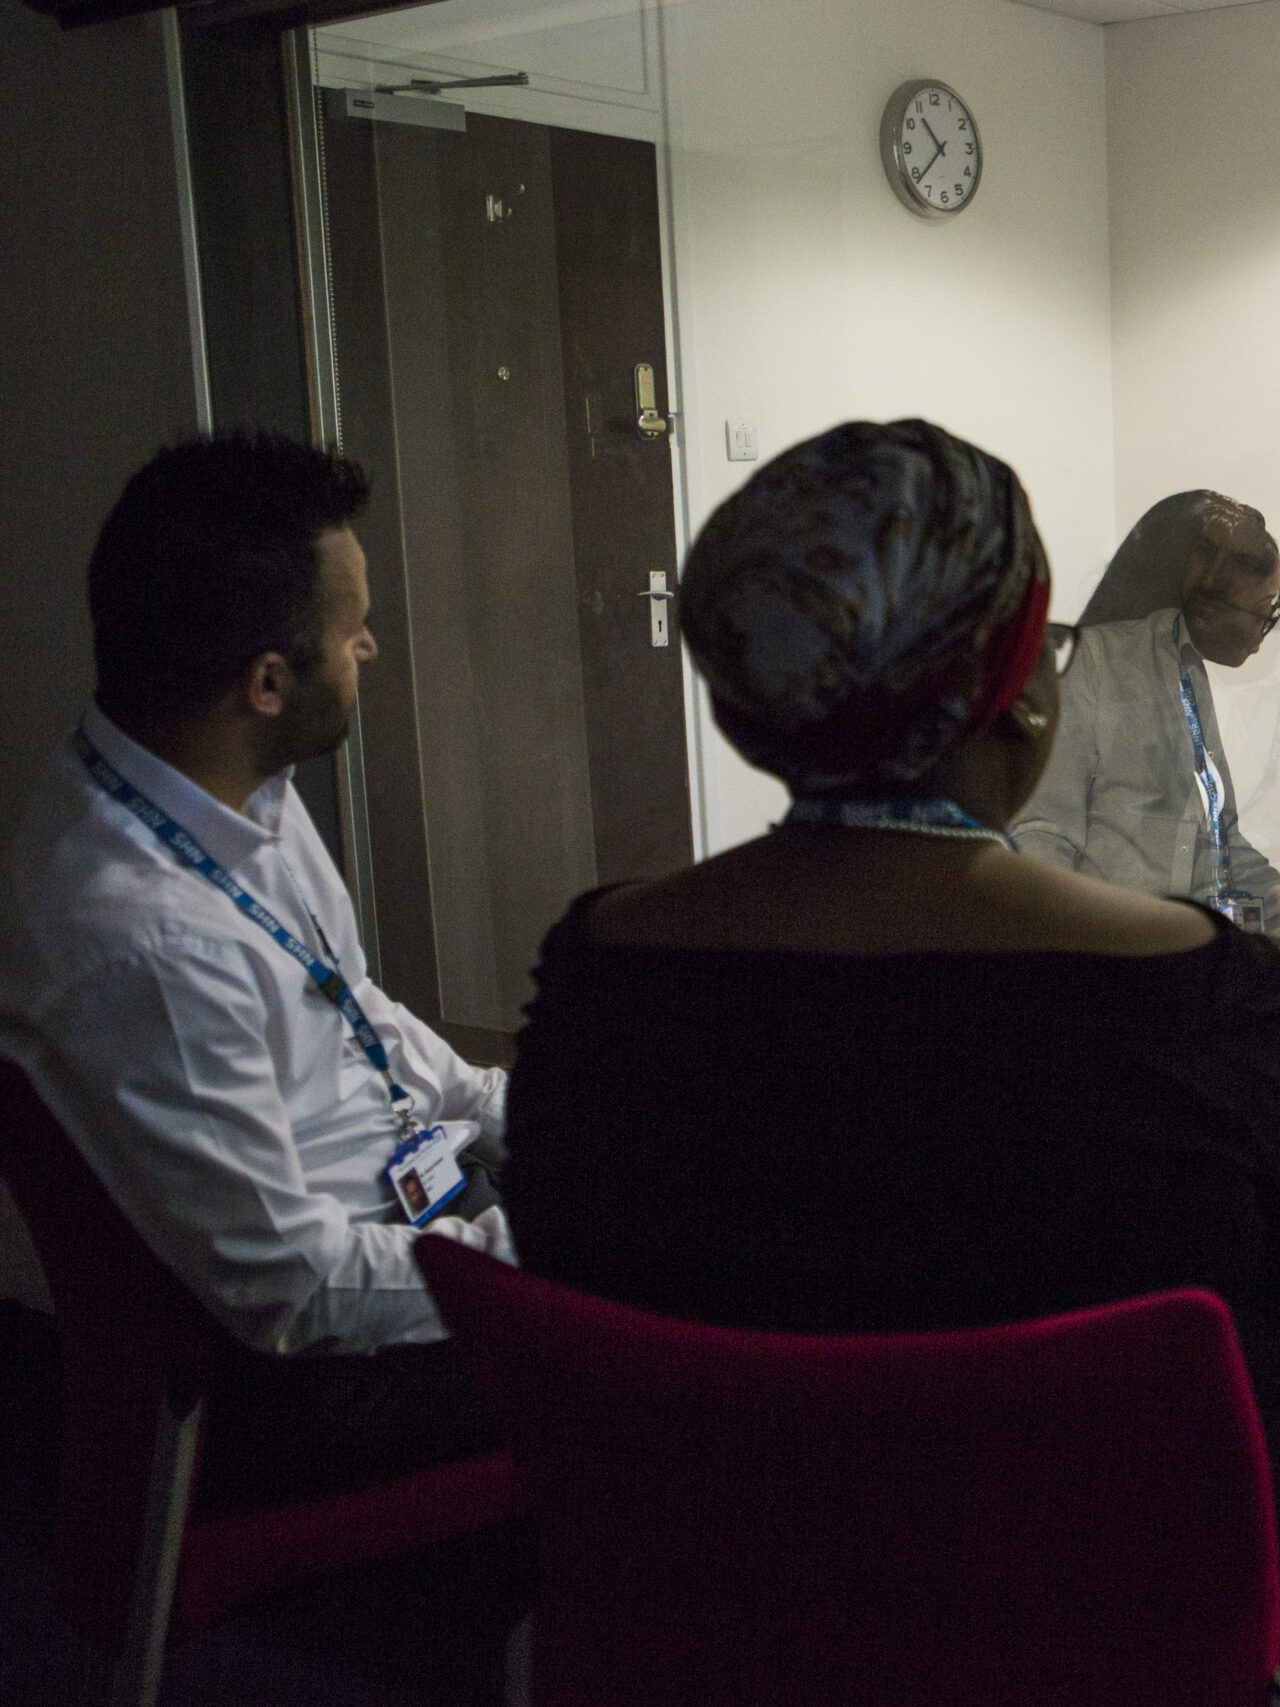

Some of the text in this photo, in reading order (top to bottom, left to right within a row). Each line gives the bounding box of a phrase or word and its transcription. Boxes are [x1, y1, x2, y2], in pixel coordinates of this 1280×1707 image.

[929, 94, 940, 106] 12
[915, 100, 923, 114] 11
[906, 118, 915, 130] 10
[958, 118, 967, 131] 2
[903, 142, 912, 154] 9
[965, 142, 974, 155] 3
[911, 166, 920, 179] 8
[963, 165, 971, 177] 4
[924, 185, 932, 197] 7
[954, 184, 964, 196] 5
[940, 191, 949, 203] 6
